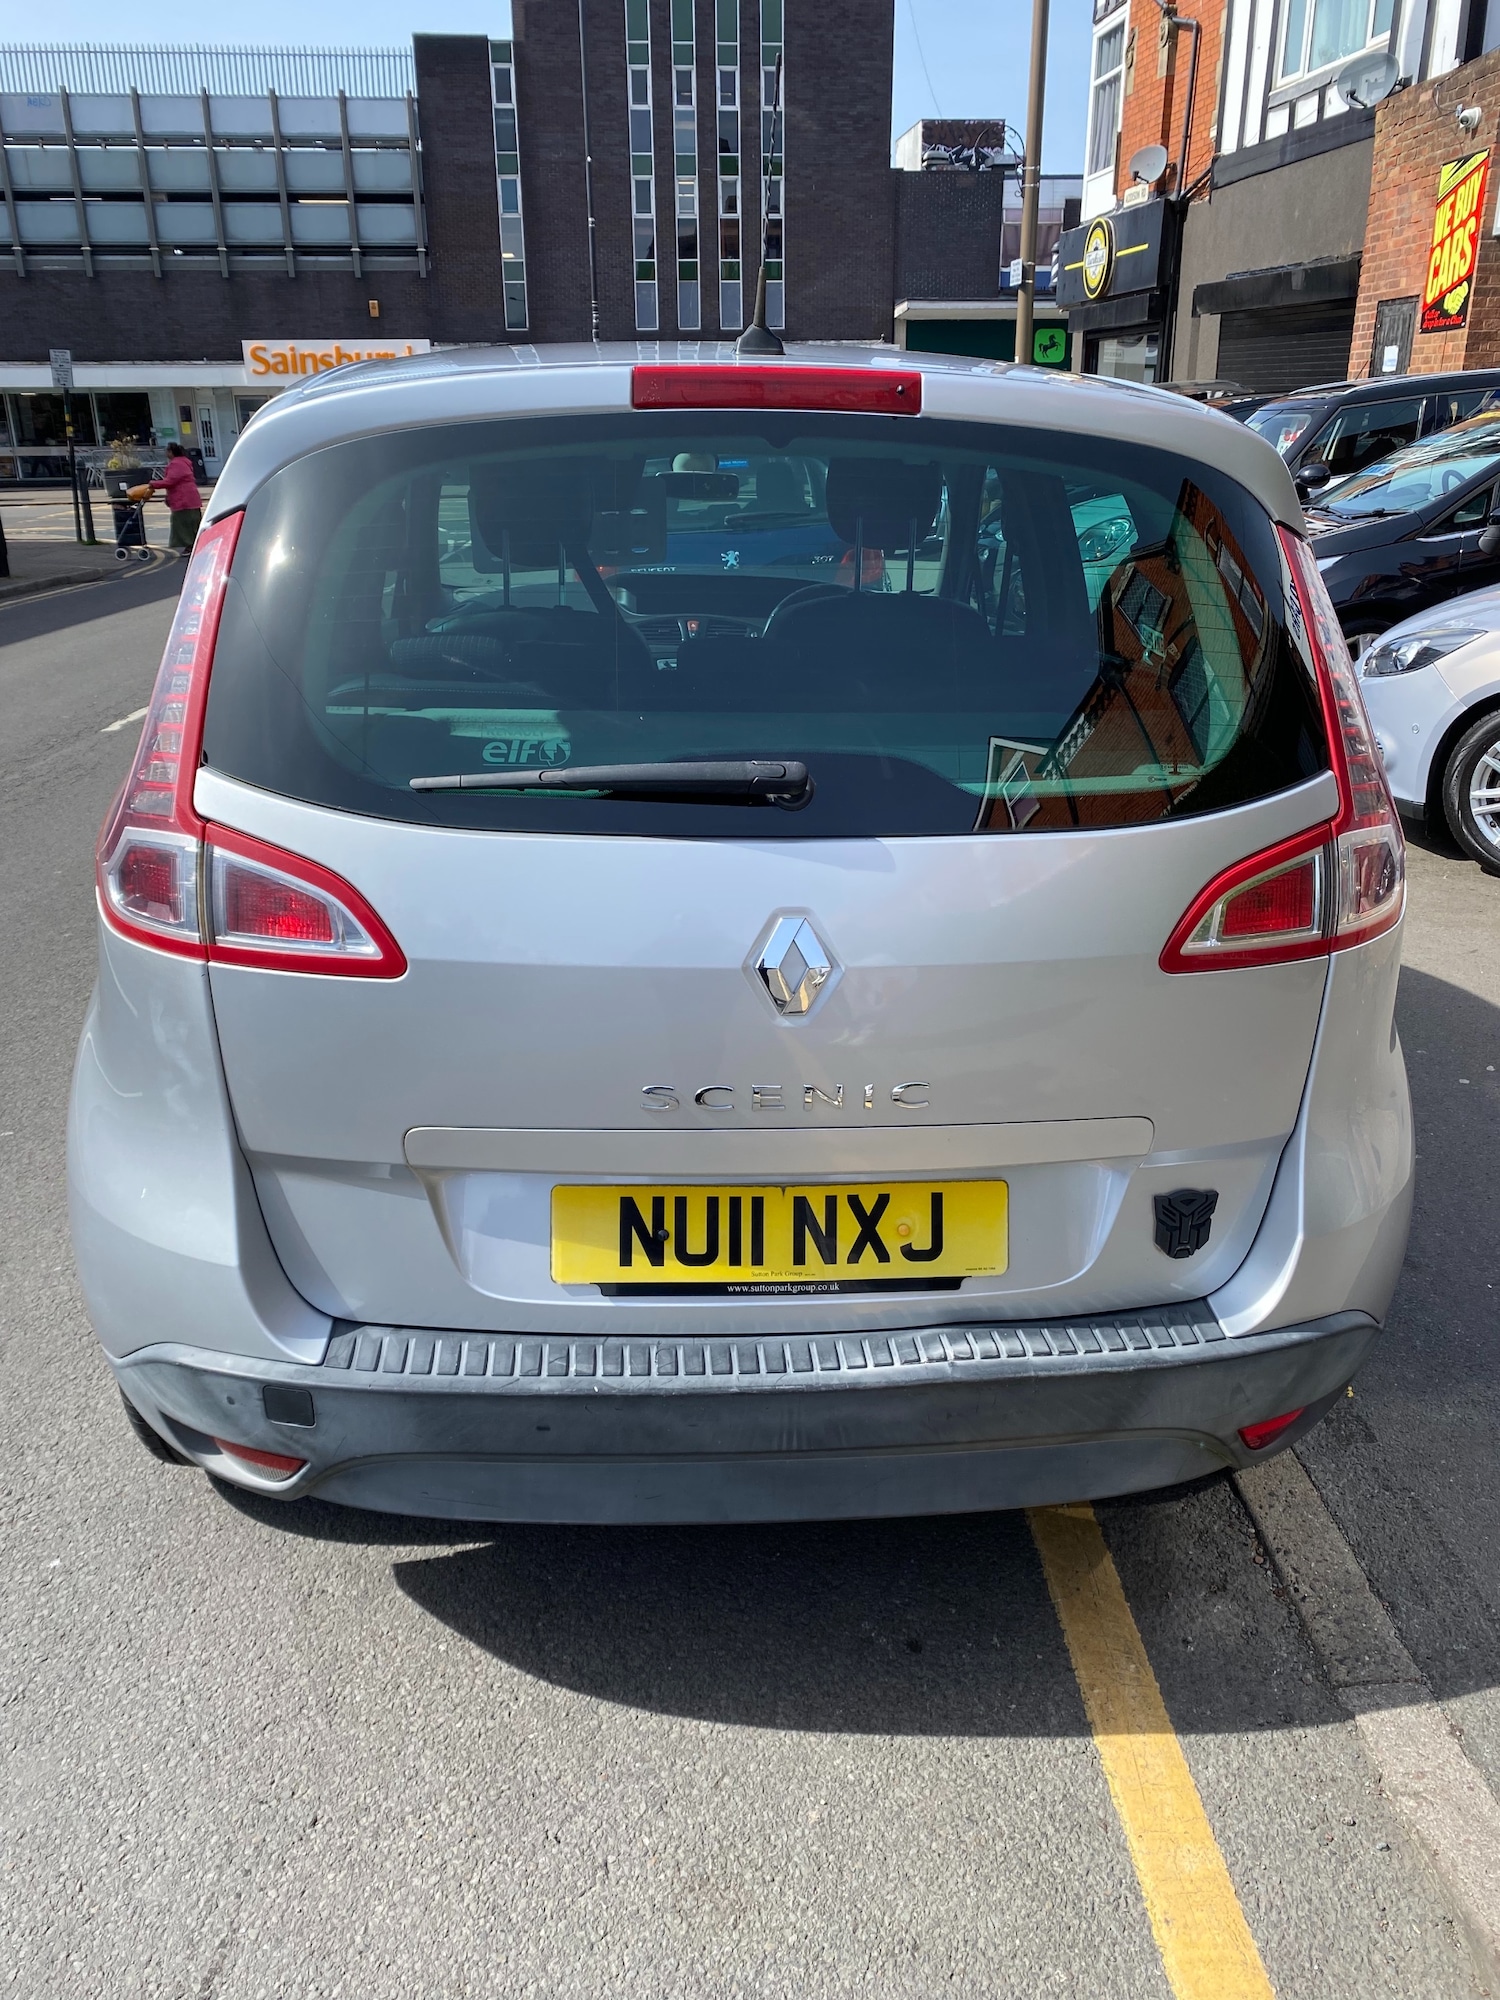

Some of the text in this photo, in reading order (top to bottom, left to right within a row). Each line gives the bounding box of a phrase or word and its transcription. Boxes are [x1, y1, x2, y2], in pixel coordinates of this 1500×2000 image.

[1433, 193, 1456, 248] WE
[1453, 165, 1485, 229] BUY
[1426, 216, 1477, 304] CARS
[250, 344, 413, 375] Sainsb'
[482, 740, 539, 763] elf
[640, 1081, 930, 1112] SCENIC
[793, 1191, 944, 1267] NXJ
[727, 1282, 840, 1294] www.suttonparkgroup.co.uk
[751, 1270, 769, 1278] Sutton
[784, 1270, 803, 1278] Group
